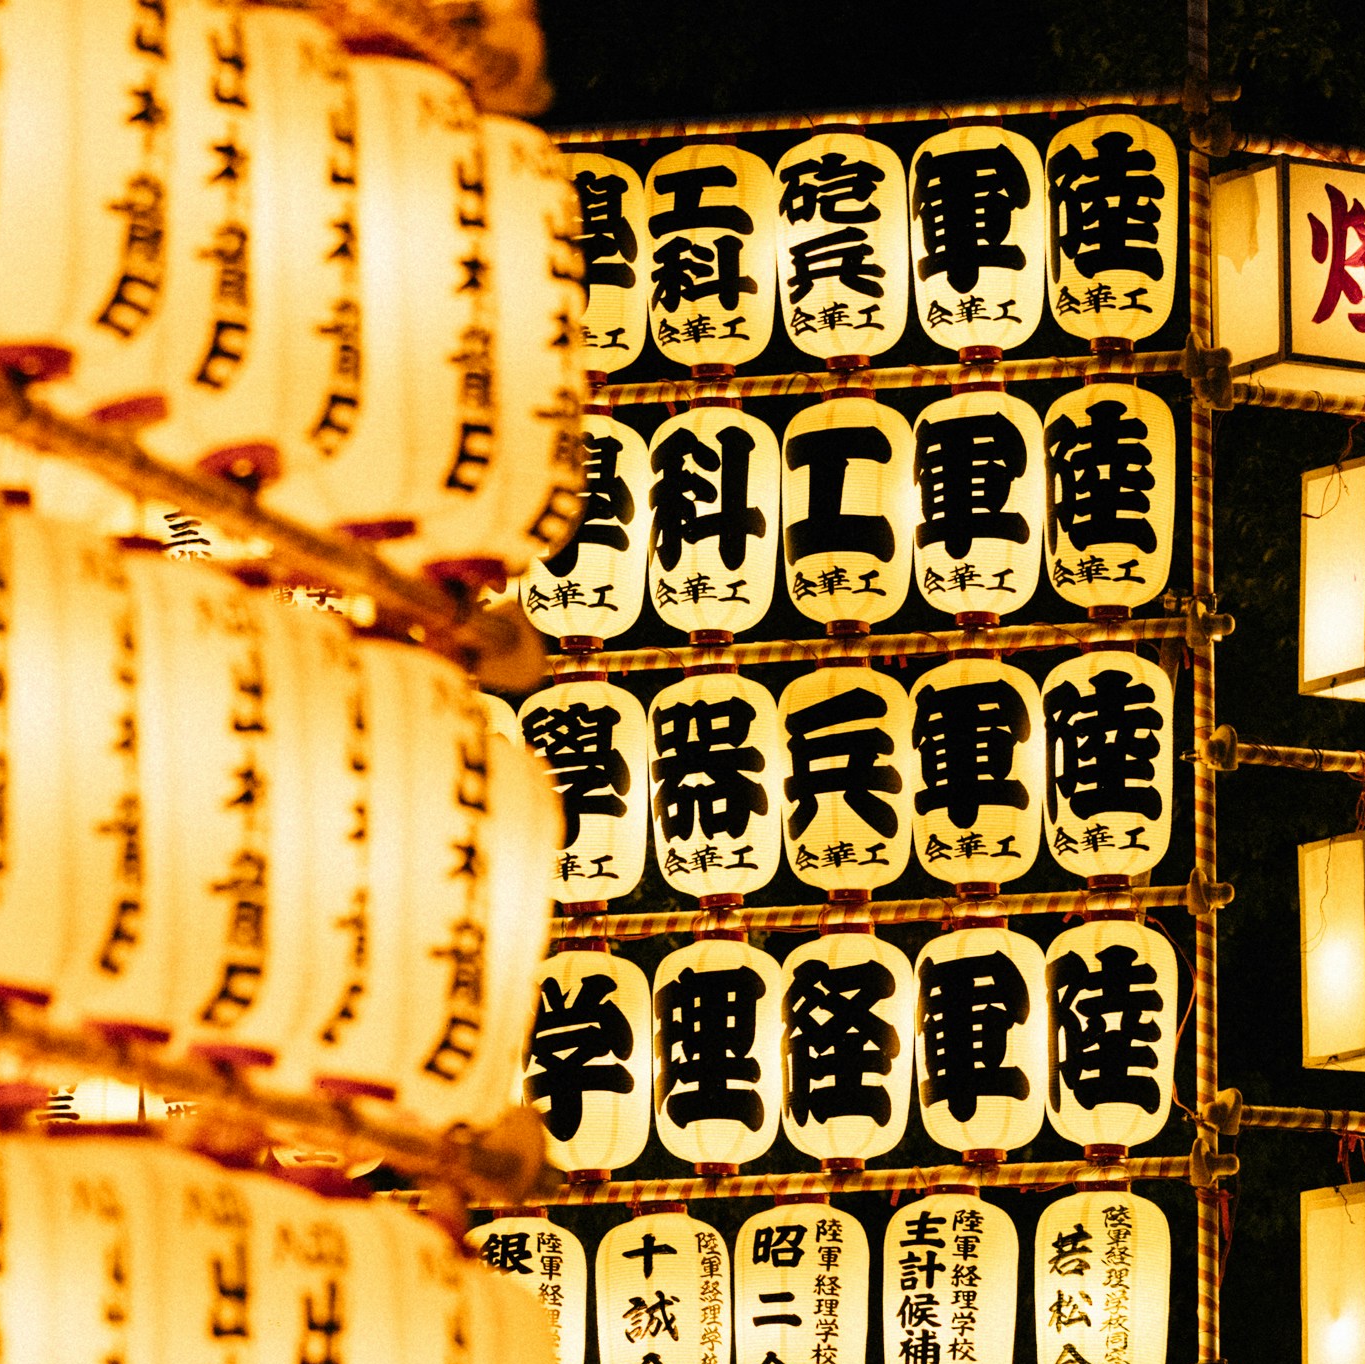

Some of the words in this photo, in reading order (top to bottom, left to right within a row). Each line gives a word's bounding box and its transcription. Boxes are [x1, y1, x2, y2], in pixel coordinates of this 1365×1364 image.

[649, 165, 758, 312] 工科
[912, 144, 1031, 293] 軍
[1047, 131, 1165, 283] 陸
[649, 425, 765, 572] 科
[785, 425, 896, 566] 工
[914, 411, 1029, 560] 軍
[1044, 400, 1157, 554] 陸
[651, 696, 768, 840] 器
[784, 687, 903, 839] 兵
[912, 680, 1031, 829] 軍
[1046, 669, 1162, 824] 陸
[653, 964, 765, 1132] 理
[783, 958, 900, 1128] 経
[917, 950, 1030, 1122] 軍
[1046, 944, 1163, 1116] 陸
